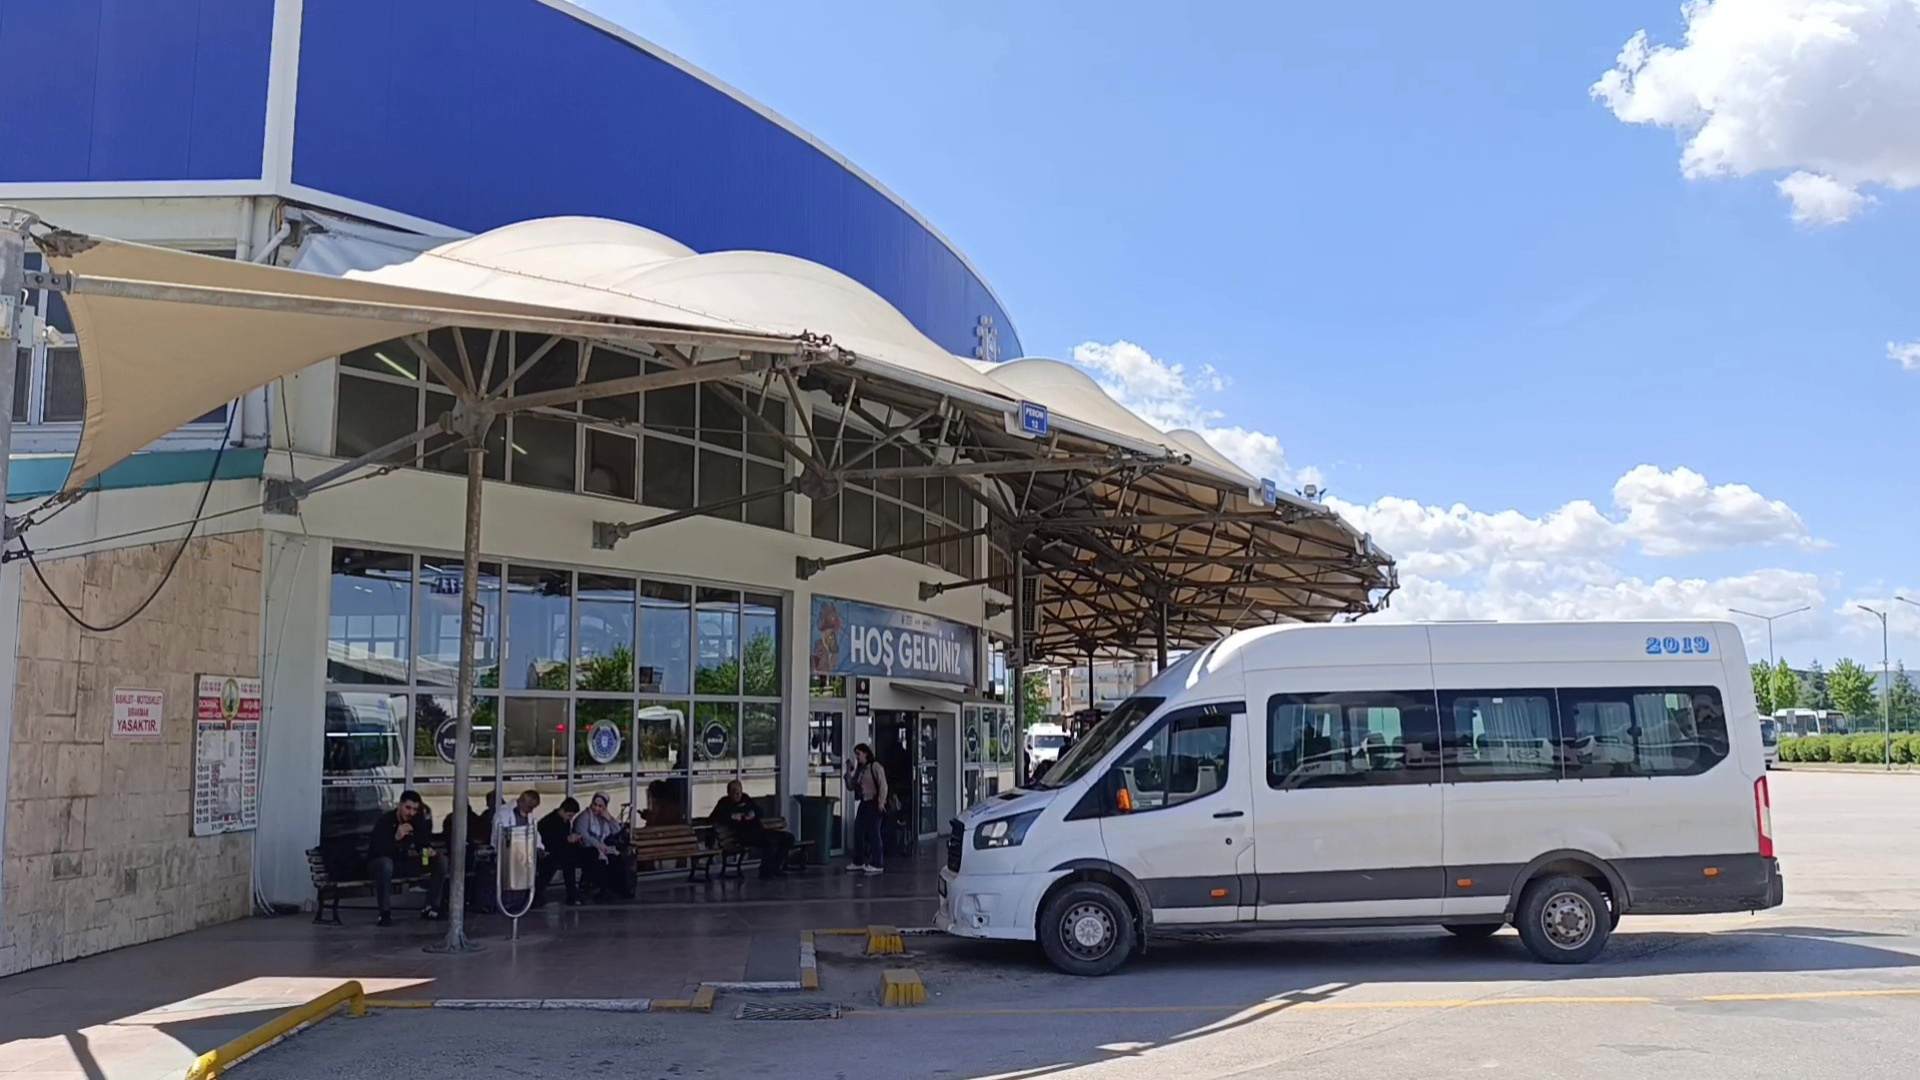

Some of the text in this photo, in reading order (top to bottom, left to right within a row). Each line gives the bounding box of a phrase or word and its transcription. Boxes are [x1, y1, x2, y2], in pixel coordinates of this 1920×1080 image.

[1025, 407, 1044, 419] PERON
[851, 624, 961, 676] HOŞ GELDİNİZ
[1645, 636, 1710, 655] 2019
[117, 719, 158, 732] YASAKTIR.
